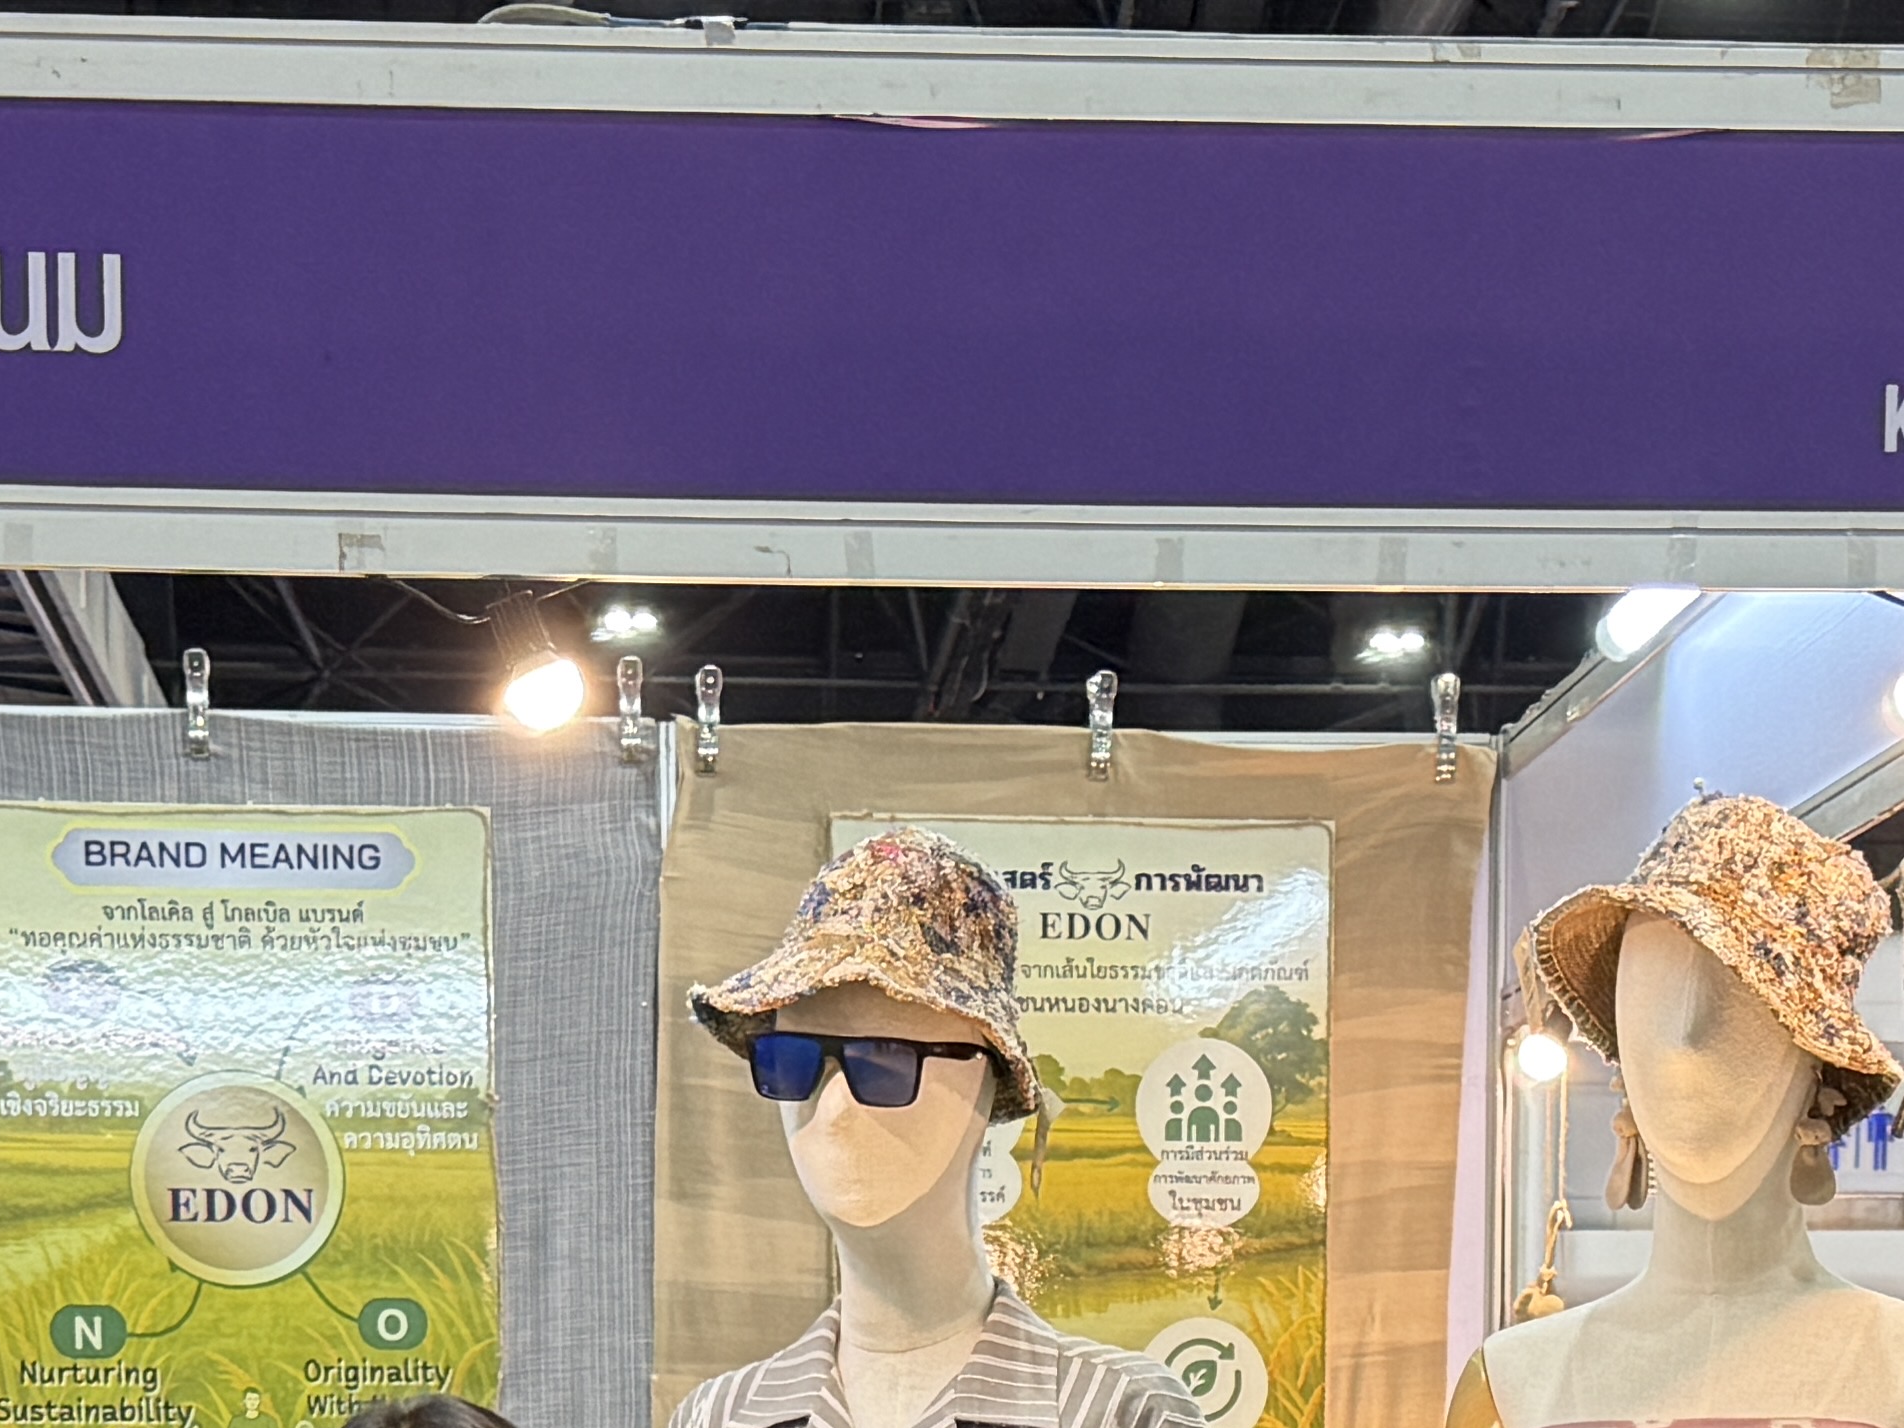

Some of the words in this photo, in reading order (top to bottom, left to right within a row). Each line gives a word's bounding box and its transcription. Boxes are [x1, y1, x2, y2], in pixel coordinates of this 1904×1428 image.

[83, 840, 208, 869] BRAND
[219, 842, 383, 871] MEANING
[1133, 864, 1265, 894] การพัฒนา
[101, 898, 194, 923] จากโลเคิล
[202, 900, 215, 931] สู่
[223, 898, 290, 924] โกลเบิล
[298, 899, 365, 924] แบรนด์
[1039, 911, 1152, 942] EDON
[312, 1063, 360, 1086] And
[368, 1063, 474, 1088] Devotion
[0, 1091, 140, 1118] เชิงจริยะธรรม
[325, 1093, 469, 1119] ความขยันและ
[344, 1123, 479, 1158] ความอุทิศตน
[1160, 1144, 1249, 1161] การมีส่วนร่วม
[166, 1187, 315, 1226] EDON
[73, 1314, 104, 1351] N
[376, 1307, 409, 1342] O
[19, 1360, 159, 1393] Nurturing
[303, 1358, 452, 1393] Originality
[307, 1393, 362, 1416] With
